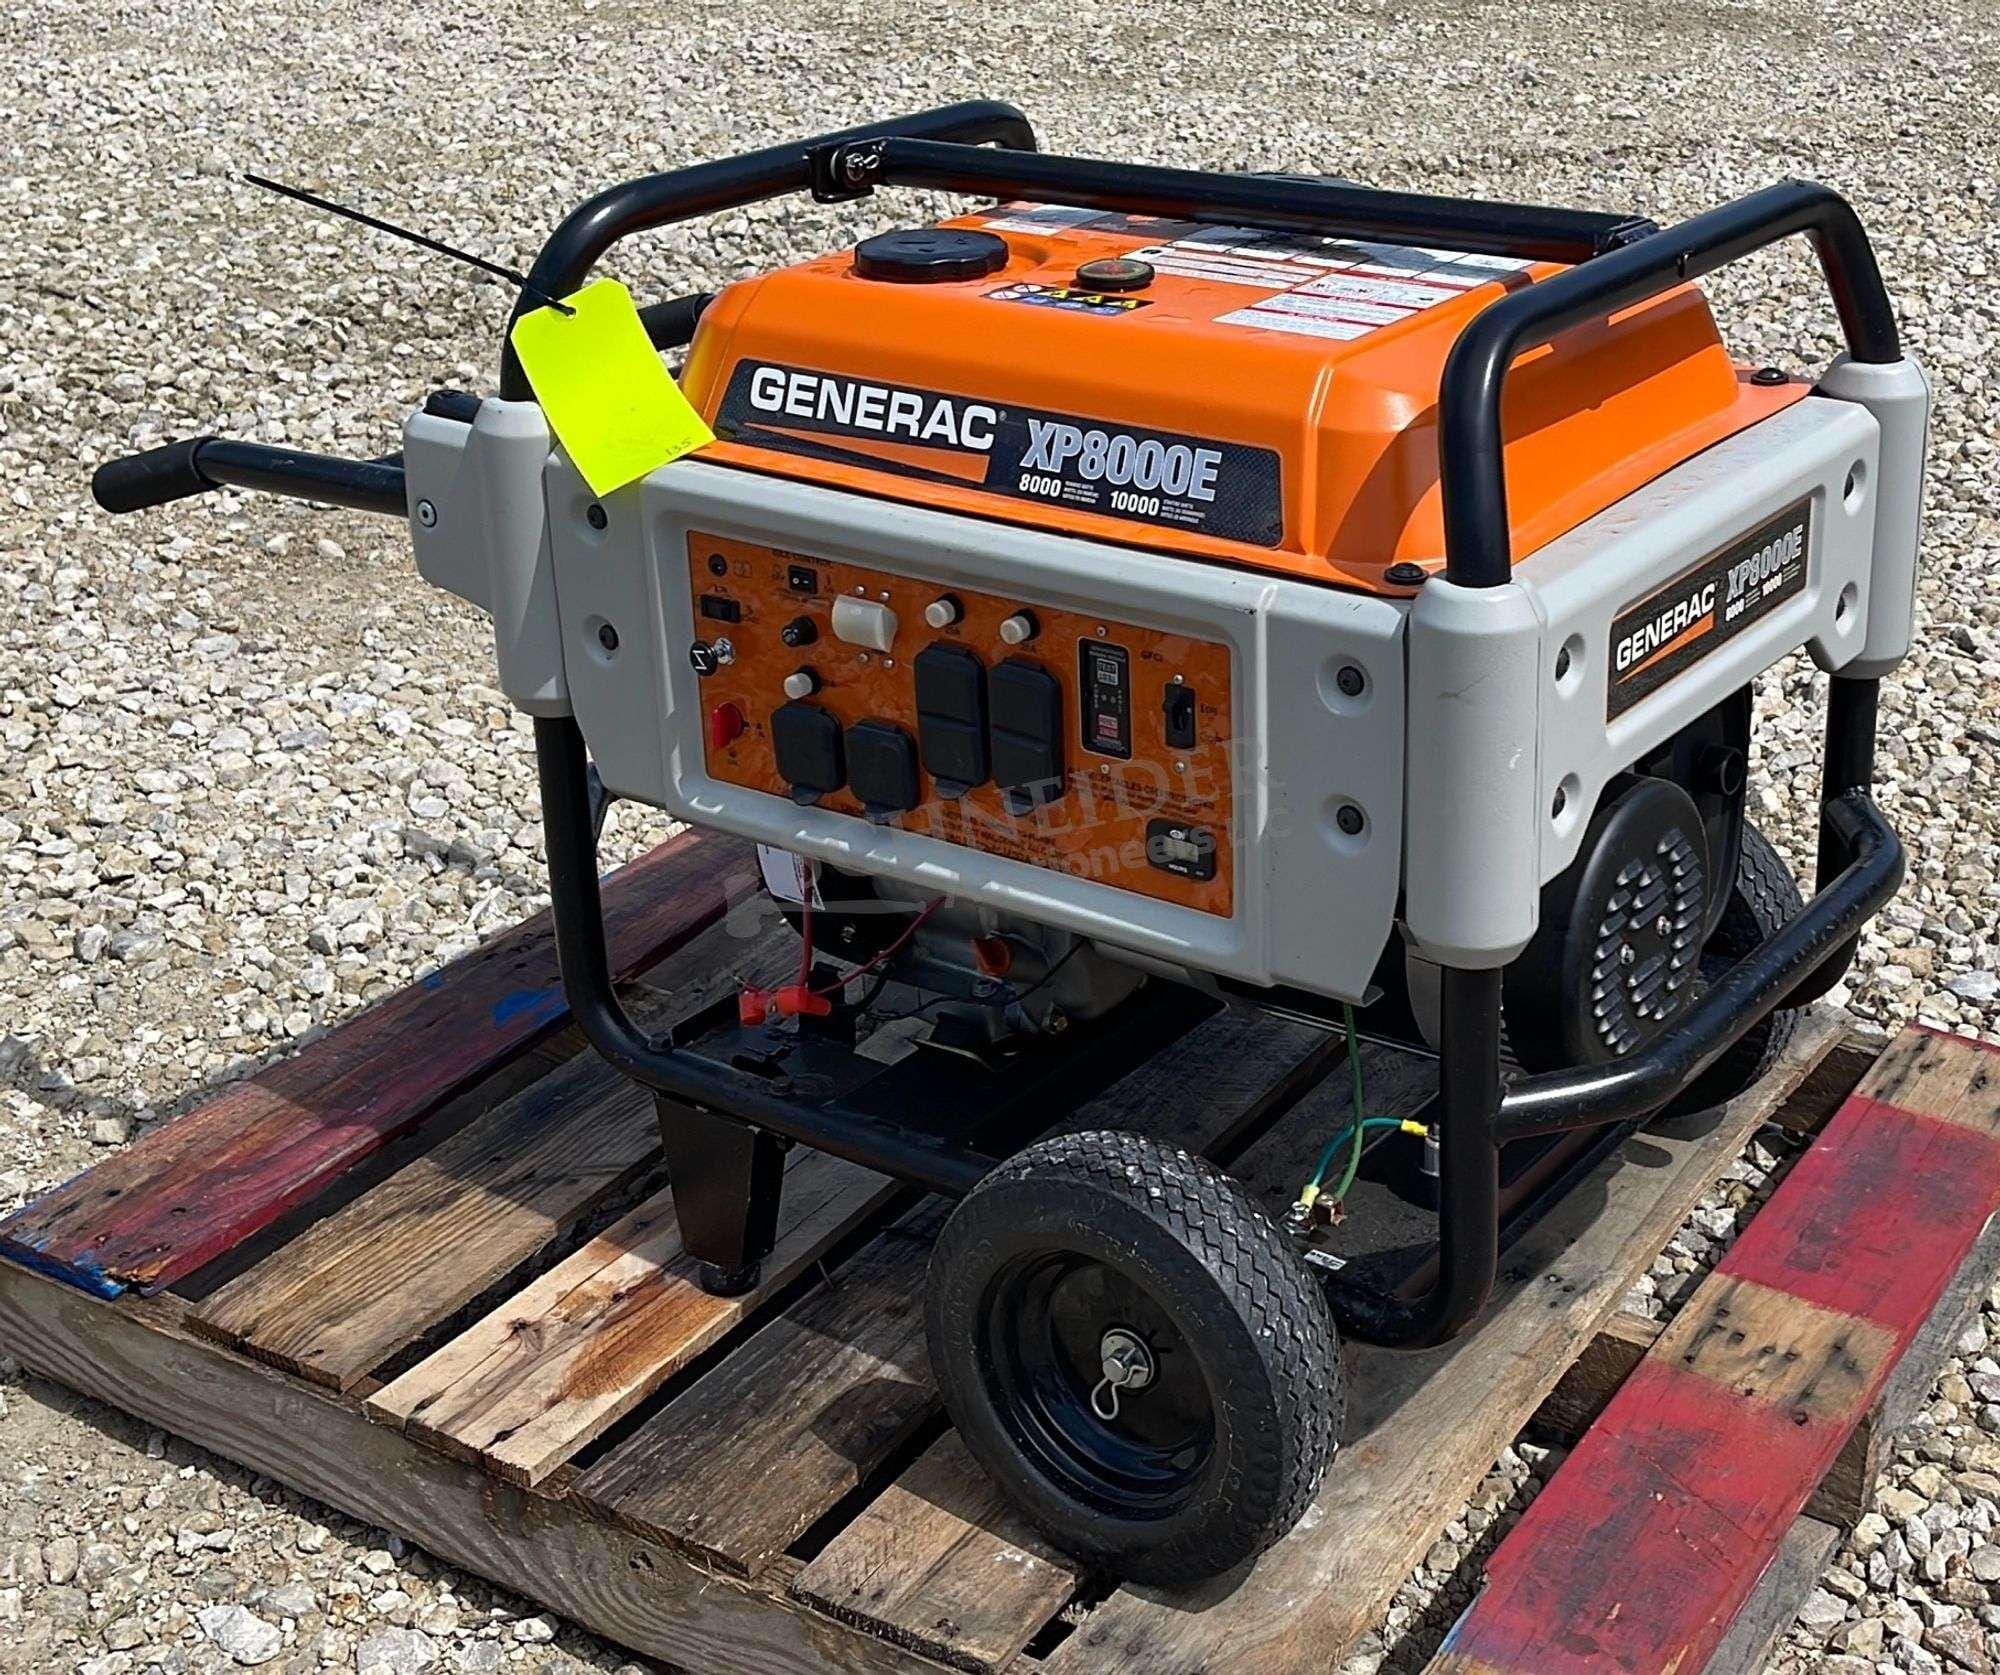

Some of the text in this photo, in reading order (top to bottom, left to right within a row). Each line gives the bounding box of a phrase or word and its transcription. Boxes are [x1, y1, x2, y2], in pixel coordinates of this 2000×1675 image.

[749, 367, 1222, 501] GENERAC XP8000E
[1019, 473, 1061, 498] 8000
[1110, 490, 1160, 516] 10000
[1616, 524, 1803, 672] GENERAC XP8000E
